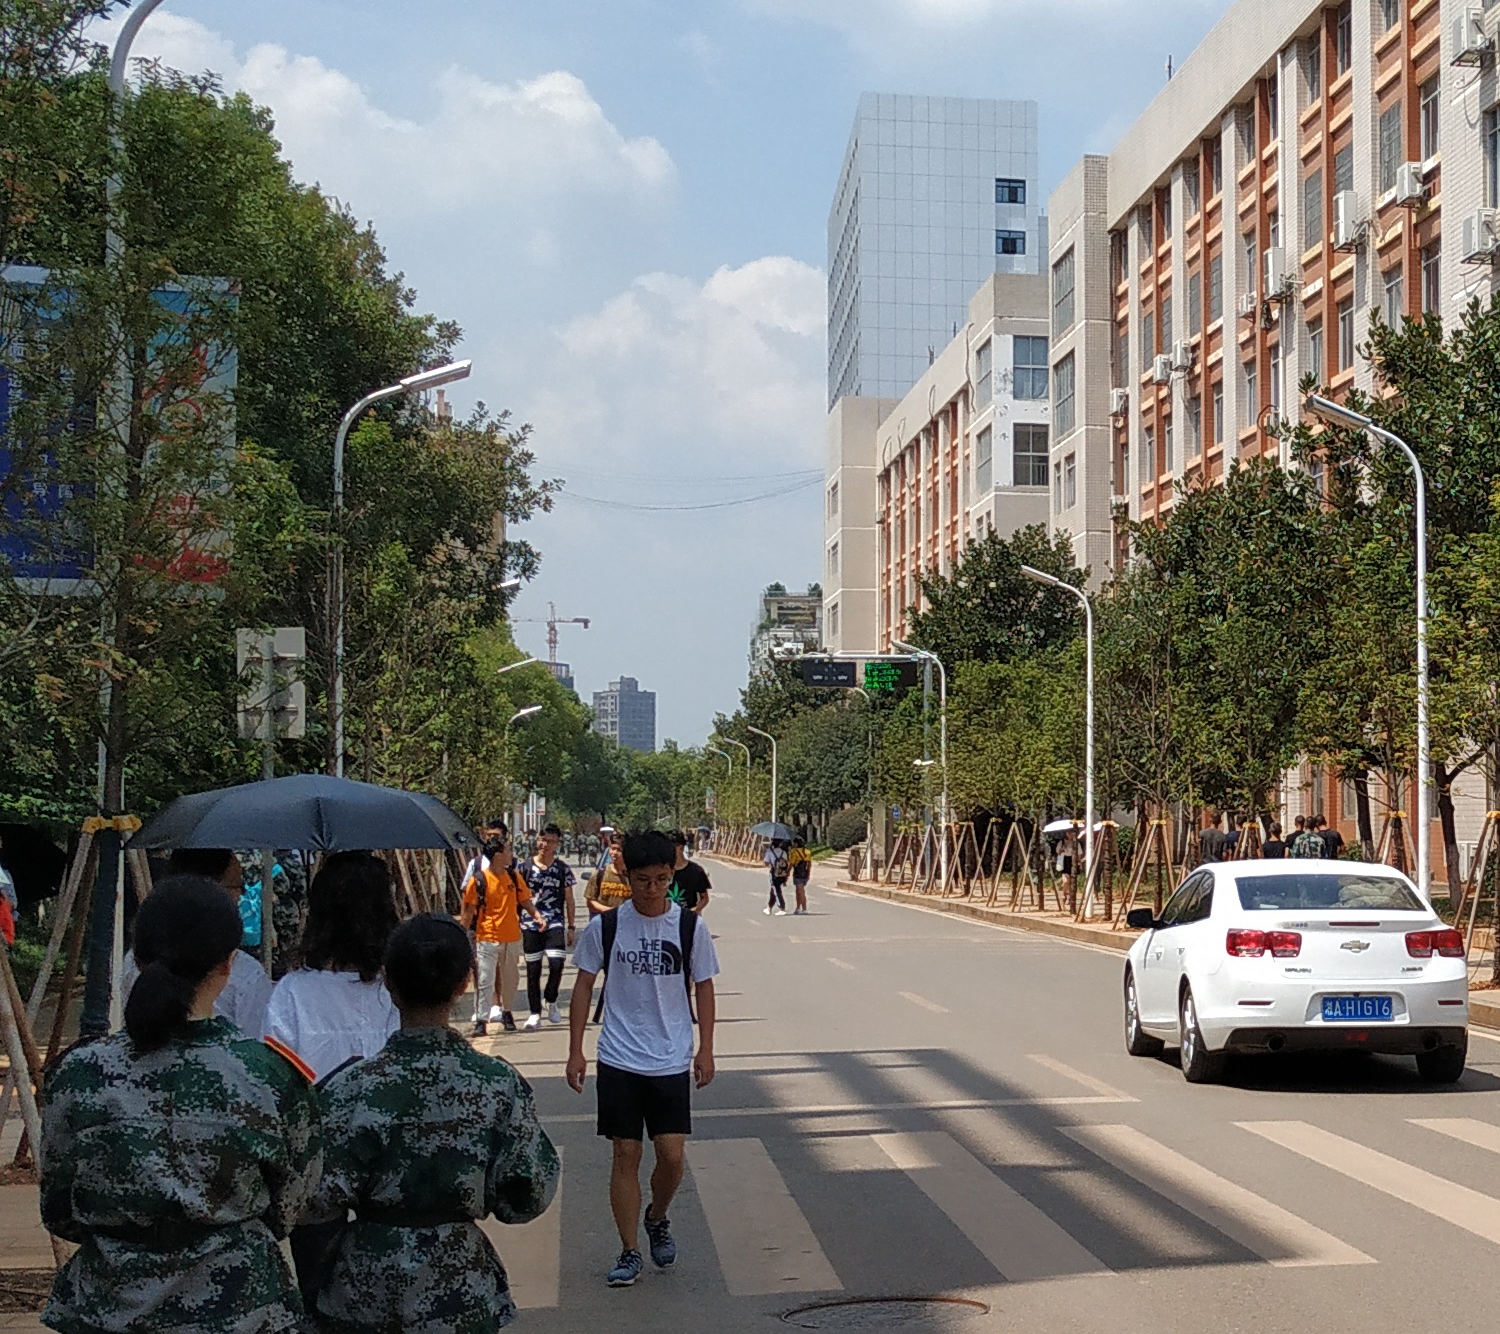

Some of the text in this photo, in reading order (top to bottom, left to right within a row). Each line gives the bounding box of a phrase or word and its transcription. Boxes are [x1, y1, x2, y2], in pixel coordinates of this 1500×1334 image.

[639, 937, 660, 951] THE
[616, 950, 660, 964] NORTH
[631, 963, 659, 975] FACE
